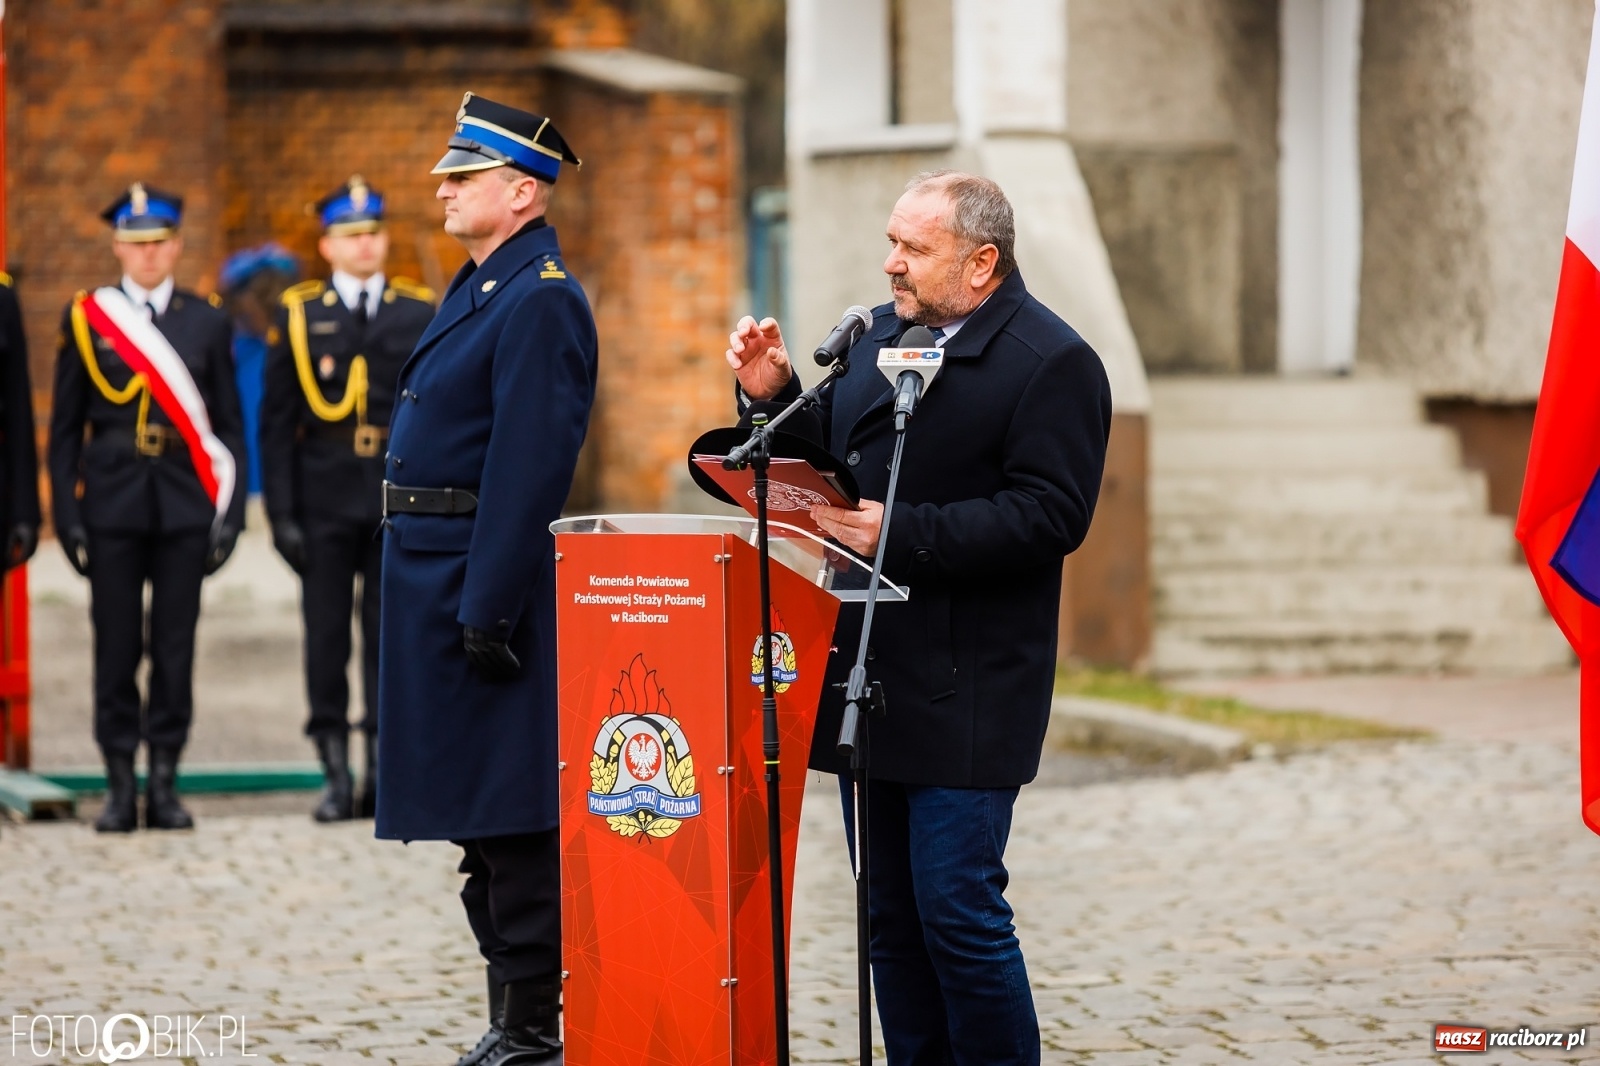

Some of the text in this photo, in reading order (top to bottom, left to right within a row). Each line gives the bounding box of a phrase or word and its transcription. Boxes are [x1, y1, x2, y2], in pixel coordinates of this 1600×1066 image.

[589, 575, 689, 587] Komenda Powiatowa
[574, 592, 706, 608] Państwowej Straży Pożarnej
[611, 611, 669, 623] w Raciborzu
[590, 790, 697, 815] PAŃSTWOWA STRAŻ POŻARNA
